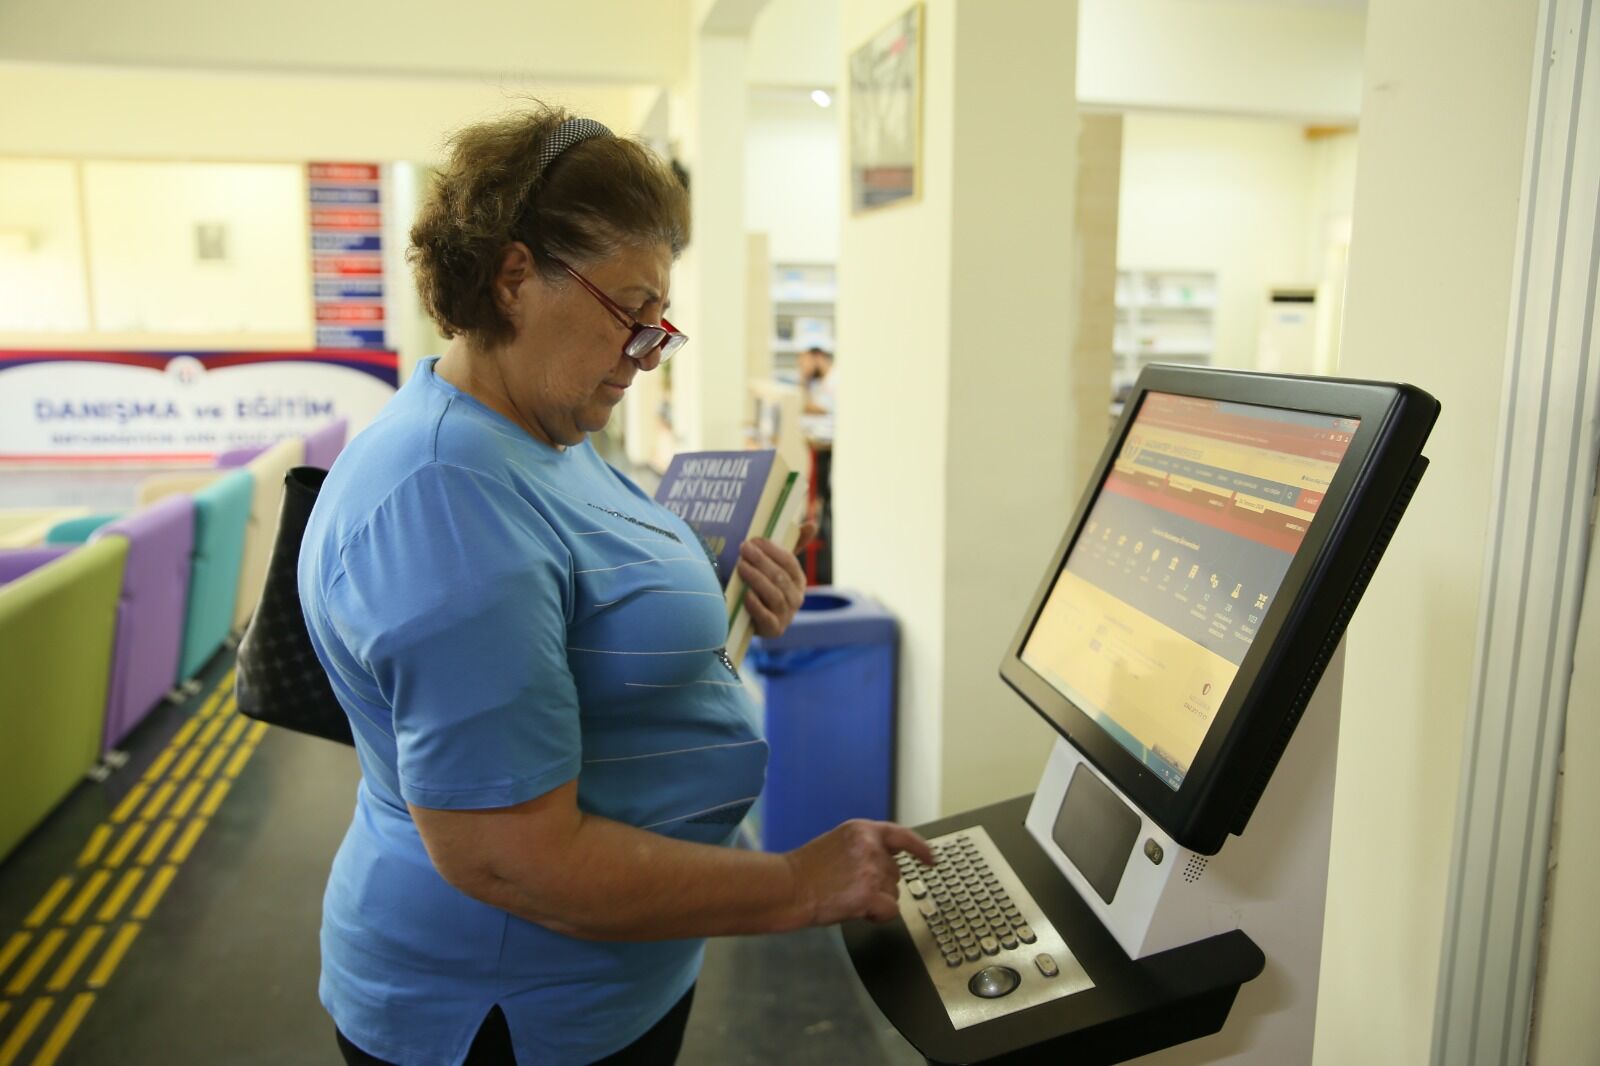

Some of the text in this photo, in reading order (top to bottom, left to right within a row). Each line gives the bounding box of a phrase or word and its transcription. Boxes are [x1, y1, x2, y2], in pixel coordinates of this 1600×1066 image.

[34, 395, 334, 424] DANIŞMA ve EĞİTİM
